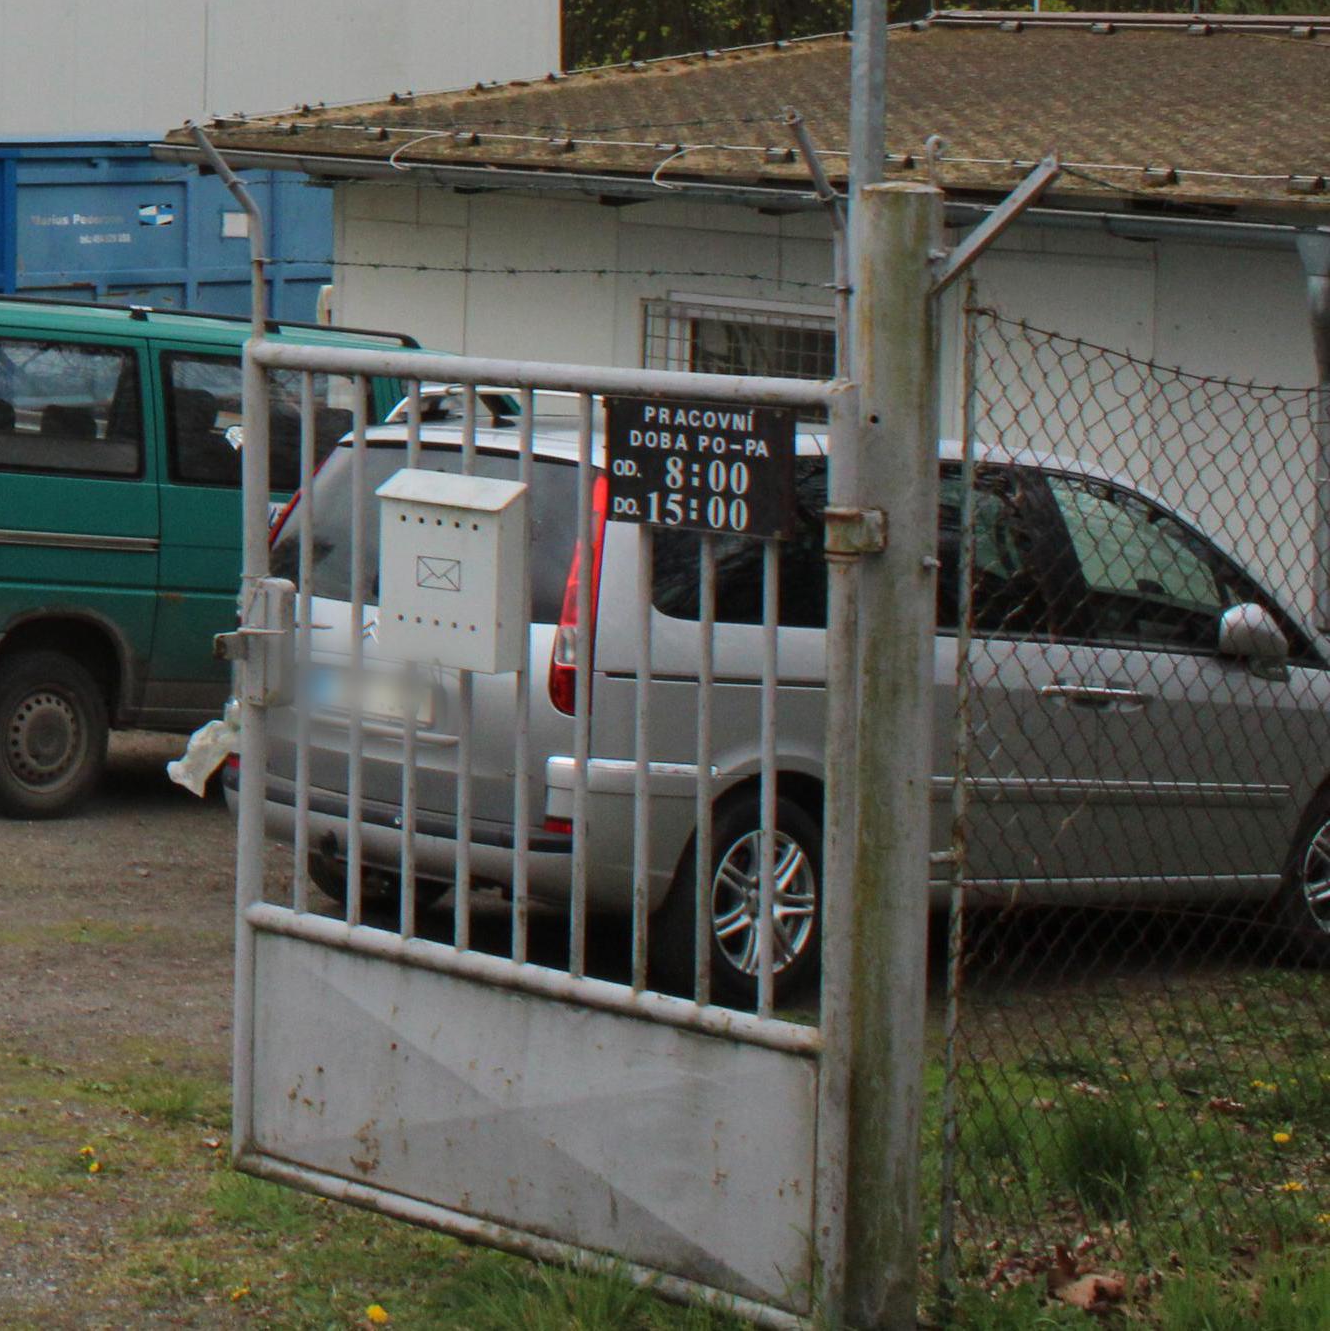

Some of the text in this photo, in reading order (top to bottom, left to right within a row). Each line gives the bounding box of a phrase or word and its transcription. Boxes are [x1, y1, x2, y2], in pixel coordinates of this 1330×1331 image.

[644, 405, 755, 431] PRACOVNÍ
[629, 429, 688, 451] DOBA
[612, 456, 750, 495] OD. 8:00
[613, 490, 749, 531] DO. 15:00
